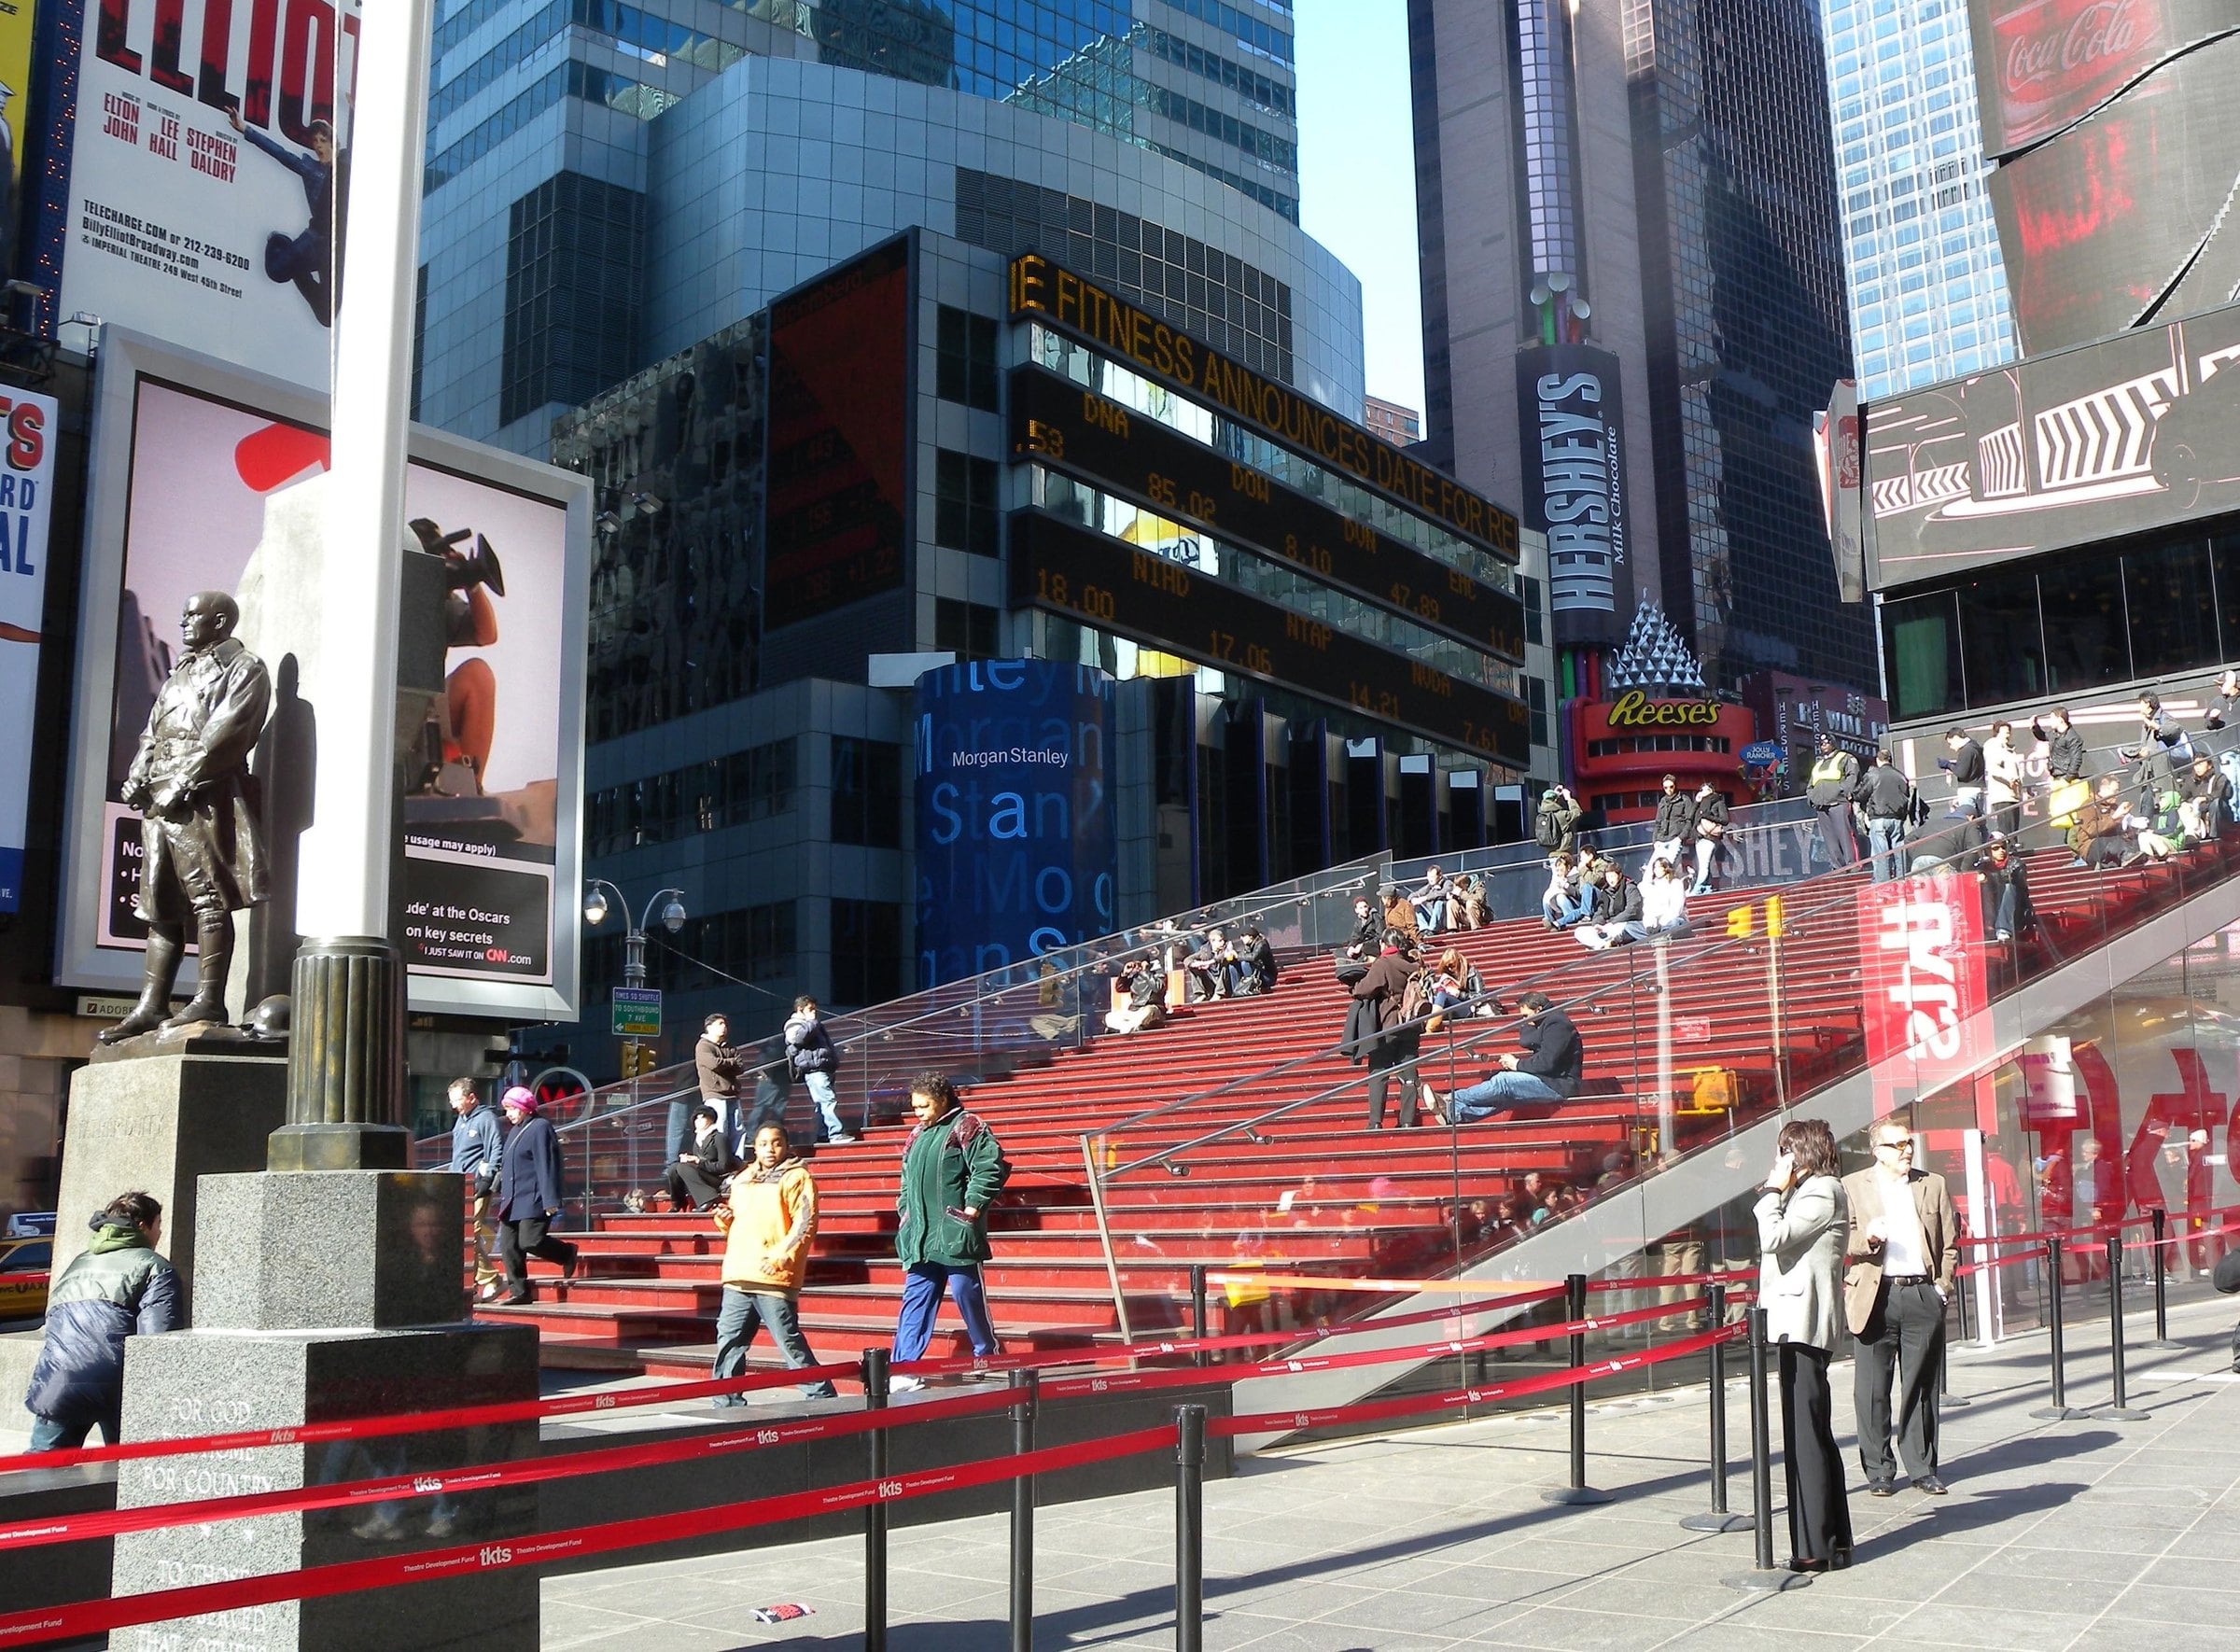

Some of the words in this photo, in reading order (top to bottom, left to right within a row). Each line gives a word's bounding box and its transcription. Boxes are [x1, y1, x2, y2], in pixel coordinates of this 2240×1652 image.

[104, 91, 139, 124] ELTON
[103, 116, 138, 145] JOHN
[161, 116, 179, 141] LEE
[149, 133, 177, 161] HALL
[187, 127, 237, 163] STEPHEN
[191, 149, 236, 184] DALDRY
[82, 217, 199, 269] BillyElliotBroadway.com
[84, 199, 167, 241] TELECHARGE.COM
[170, 233, 181, 246] or
[184, 236, 250, 271] 212-239-6200
[91, 237, 127, 259] IMPERIAL
[131, 250, 161, 271] THEATRE
[180, 269, 199, 284] West
[201, 277, 217, 290] 45th
[219, 282, 243, 299] Street
[1057, 269, 1195, 385] FITNESS
[1203, 351, 1369, 479] ANNOUNCES
[1377, 442, 1435, 513] DATE
[1440, 479, 1484, 545] FOR
[1488, 504, 1517, 560] RE
[1083, 392, 1128, 439] DNA
[1606, 425, 1622, 519] Chocolate
[1147, 471, 1216, 525] 85.02
[1537, 372, 1615, 612] HERSHEY'S
[1614, 515, 1625, 566] Milk
[1132, 551, 1190, 597] NIHD
[1037, 567, 1115, 621] 18.00
[1608, 689, 1722, 726] Reese's
[952, 749, 1007, 768] Morgan
[1010, 747, 1070, 769] Stanley
[1746, 751, 1777, 760] RANCHER
[1752, 746, 1771, 754] JOLLY
[411, 834, 441, 848] usage
[442, 839, 464, 853] may
[465, 842, 497, 856] apply)
[432, 905, 444, 917] at
[447, 904, 466, 920] the
[468, 907, 511, 925] Oscars
[406, 926, 422, 938] on
[425, 926, 446, 943] key
[449, 930, 493, 945] secrets
[428, 946, 447, 957] JUST
[448, 948, 465, 959] SAW
[465, 950, 472, 959] IT
[473, 951, 484, 960] ON
[635, 1015, 646, 1023] AVE
[2014, 1039, 2240, 1288] tkt
[973, 1358, 987, 1369] tkts
[1091, 1378, 1108, 1392] tkts
[595, 1395, 615, 1407] tkts
[270, 1430, 296, 1444] tkts
[757, 1428, 778, 1445] tkts
[185, 1468, 273, 1494] COUNTRY
[350, 1488, 367, 1496] Theatre
[369, 1485, 397, 1494] Development
[413, 1477, 443, 1493] tkts
[444, 1476, 460, 1484] Theatre
[462, 1473, 489, 1482] Development
[822, 1495, 837, 1504] Theatre
[839, 1491, 863, 1502] Development
[878, 1480, 903, 1498] tkts
[921, 1477, 944, 1486] Development
[13, 1528, 50, 1537] Development
[51, 1525, 67, 1533] Fund
[404, 1562, 424, 1572] Theatre
[426, 1558, 459, 1570] Development
[461, 1556, 474, 1564] Fund
[480, 1546, 512, 1567] tkts
[517, 1545, 535, 1555] Theatre
[537, 1540, 567, 1552] Development
[569, 1538, 581, 1547] Fund
[44, 1618, 63, 1629] Fund
